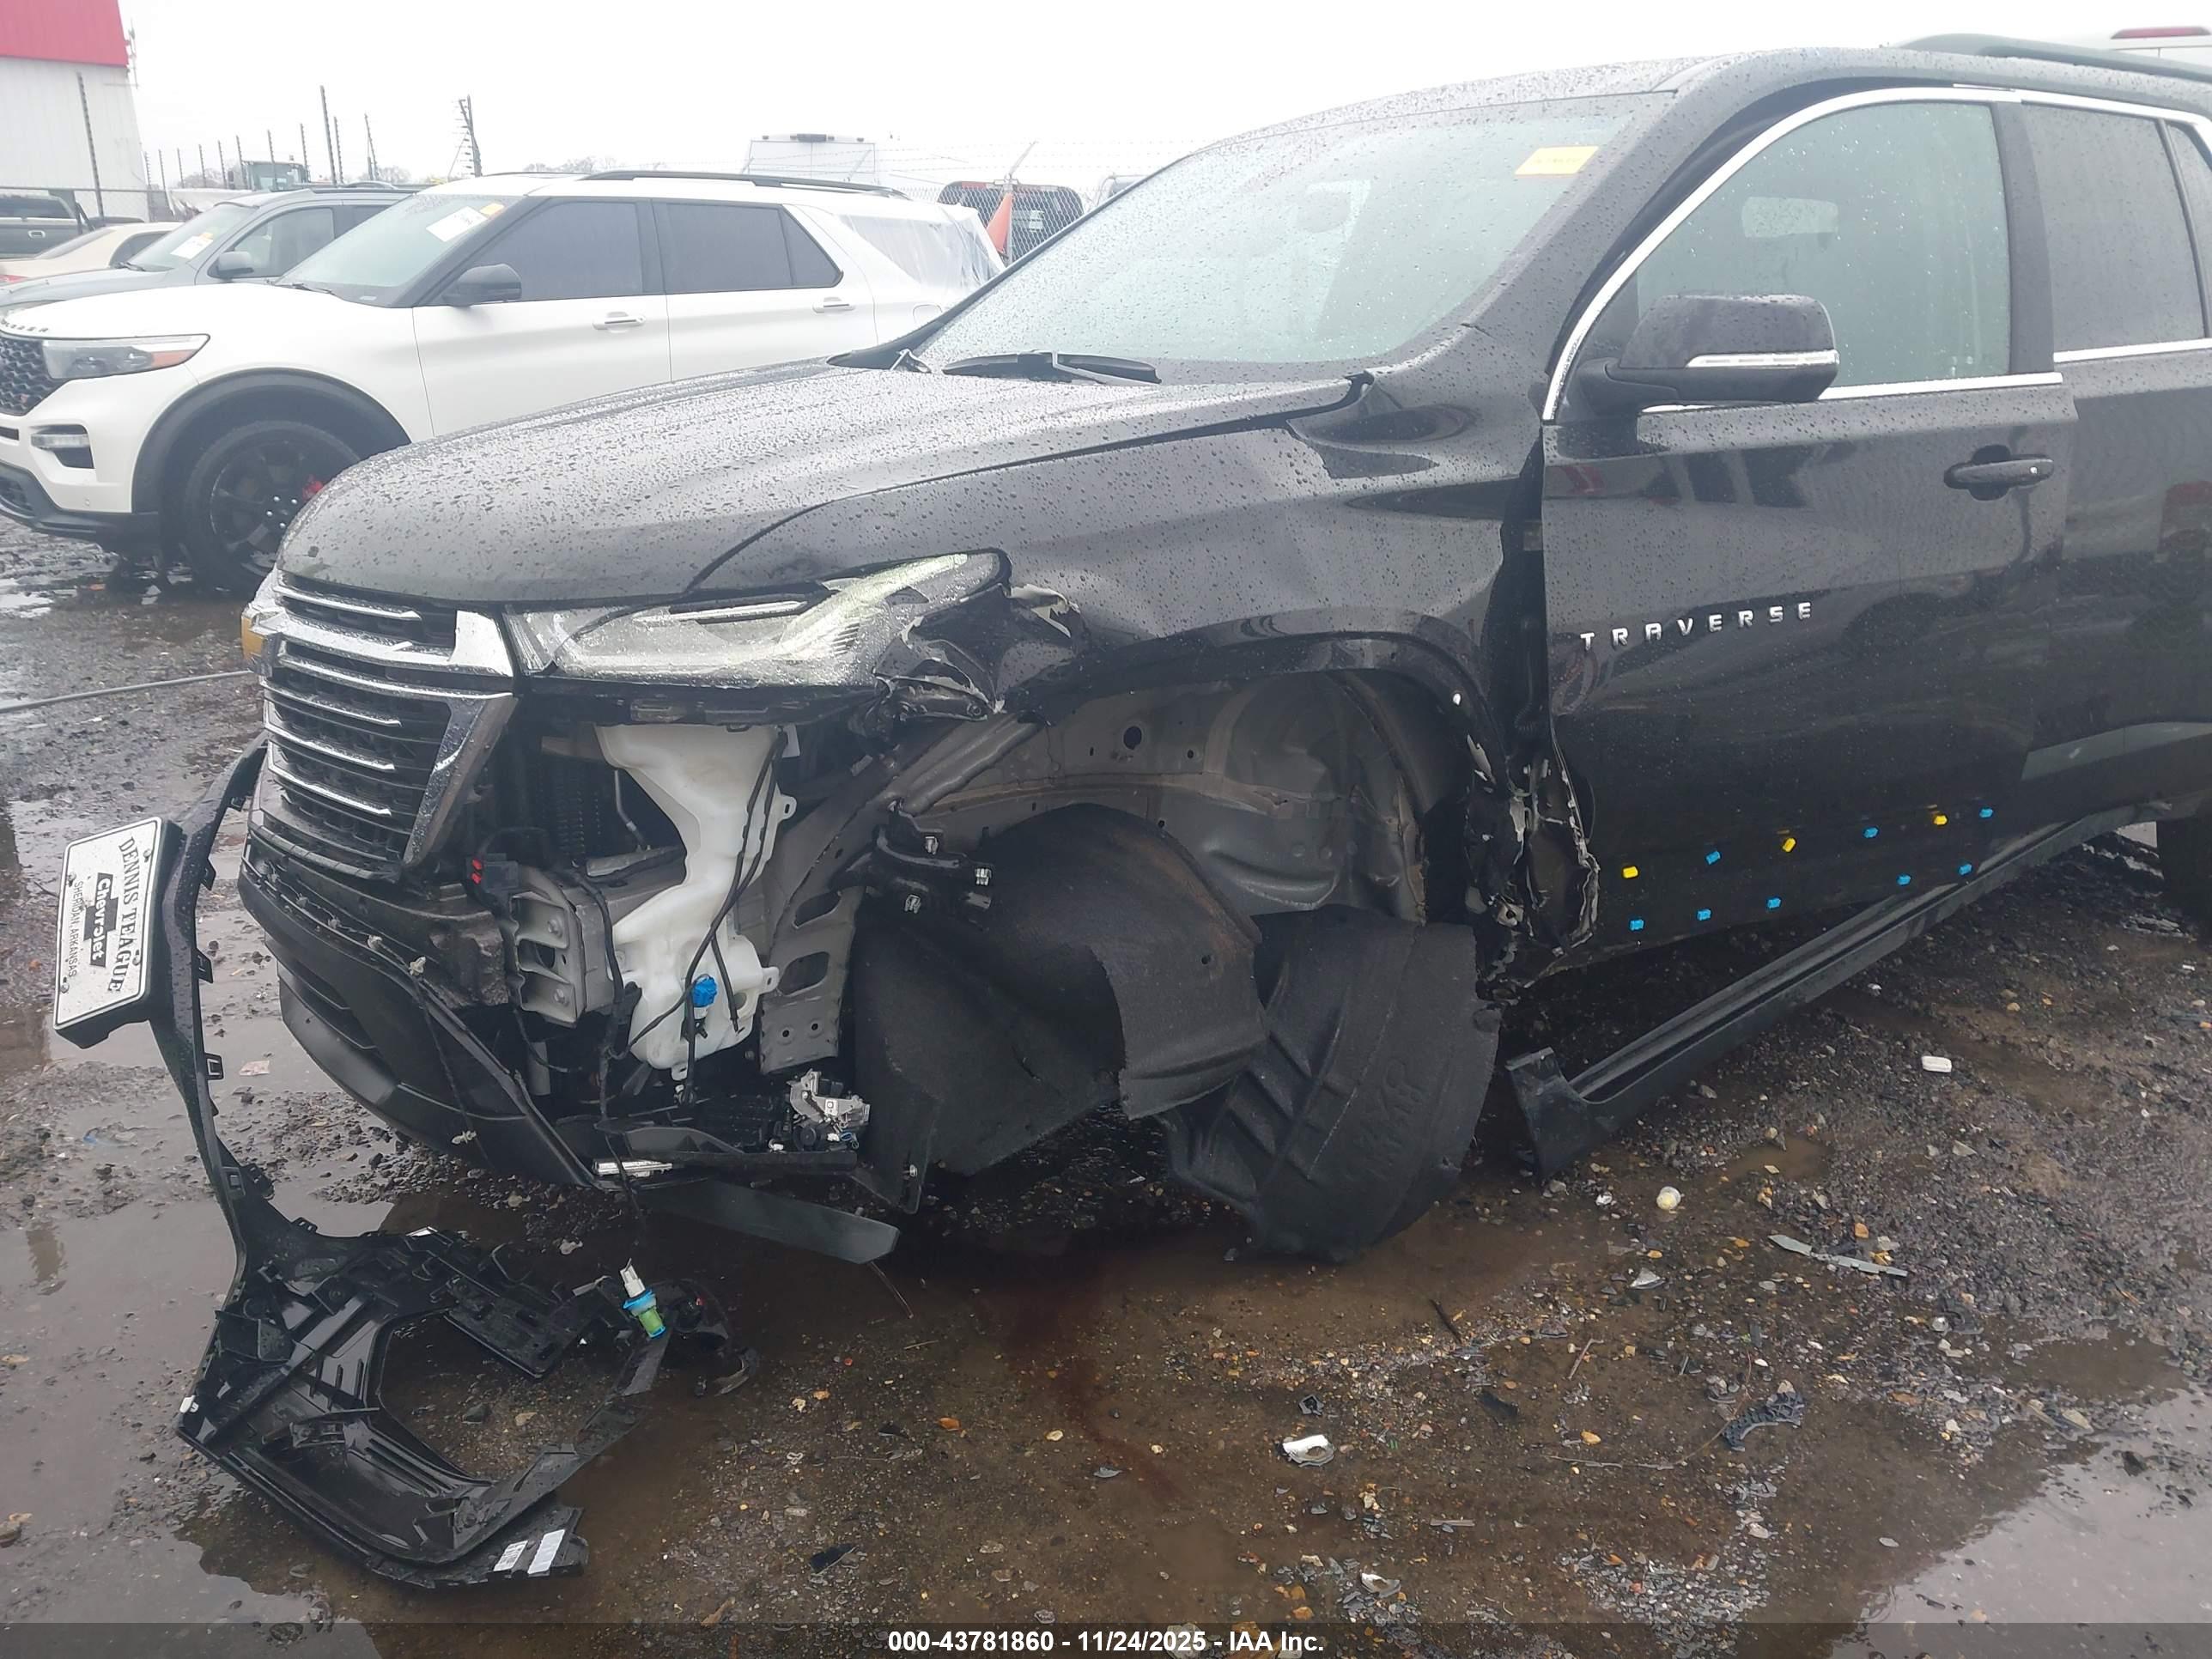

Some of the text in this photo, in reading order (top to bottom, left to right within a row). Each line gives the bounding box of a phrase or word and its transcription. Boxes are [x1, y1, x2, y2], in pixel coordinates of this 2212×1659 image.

[1580, 602, 1813, 651] TRAVERSE
[92, 877, 112, 961] Chevrolet
[107, 836, 140, 993] DENNIS TEAGUE
[68, 928, 80, 978] ARKANSAS
